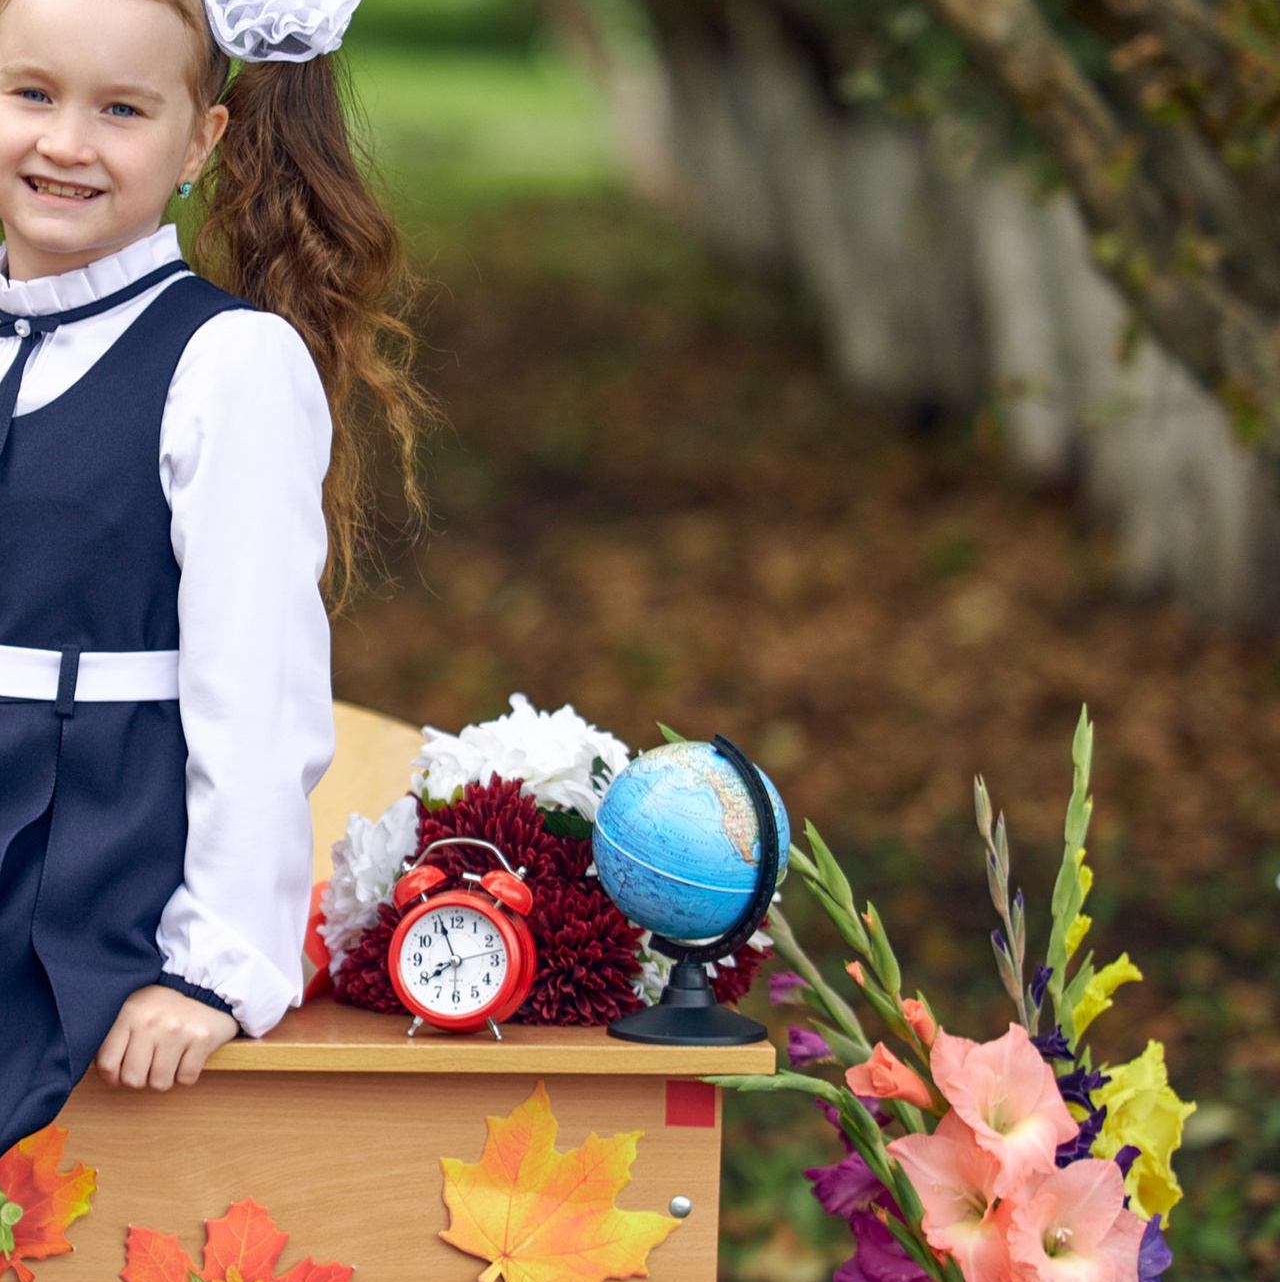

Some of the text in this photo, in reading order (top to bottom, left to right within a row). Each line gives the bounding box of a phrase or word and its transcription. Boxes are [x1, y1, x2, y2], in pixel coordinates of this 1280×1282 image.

[450, 916, 464, 929] 12
[472, 921, 478, 933] 1
[419, 935, 432, 948] 10
[484, 934, 494, 948] 2
[413, 952, 422, 967] 9
[490, 954, 500, 967] 3
[419, 972, 429, 986] 8
[482, 972, 491, 985] 4
[434, 986, 442, 999] 7
[451, 990, 461, 1004] 6
[470, 986, 479, 998] 5
